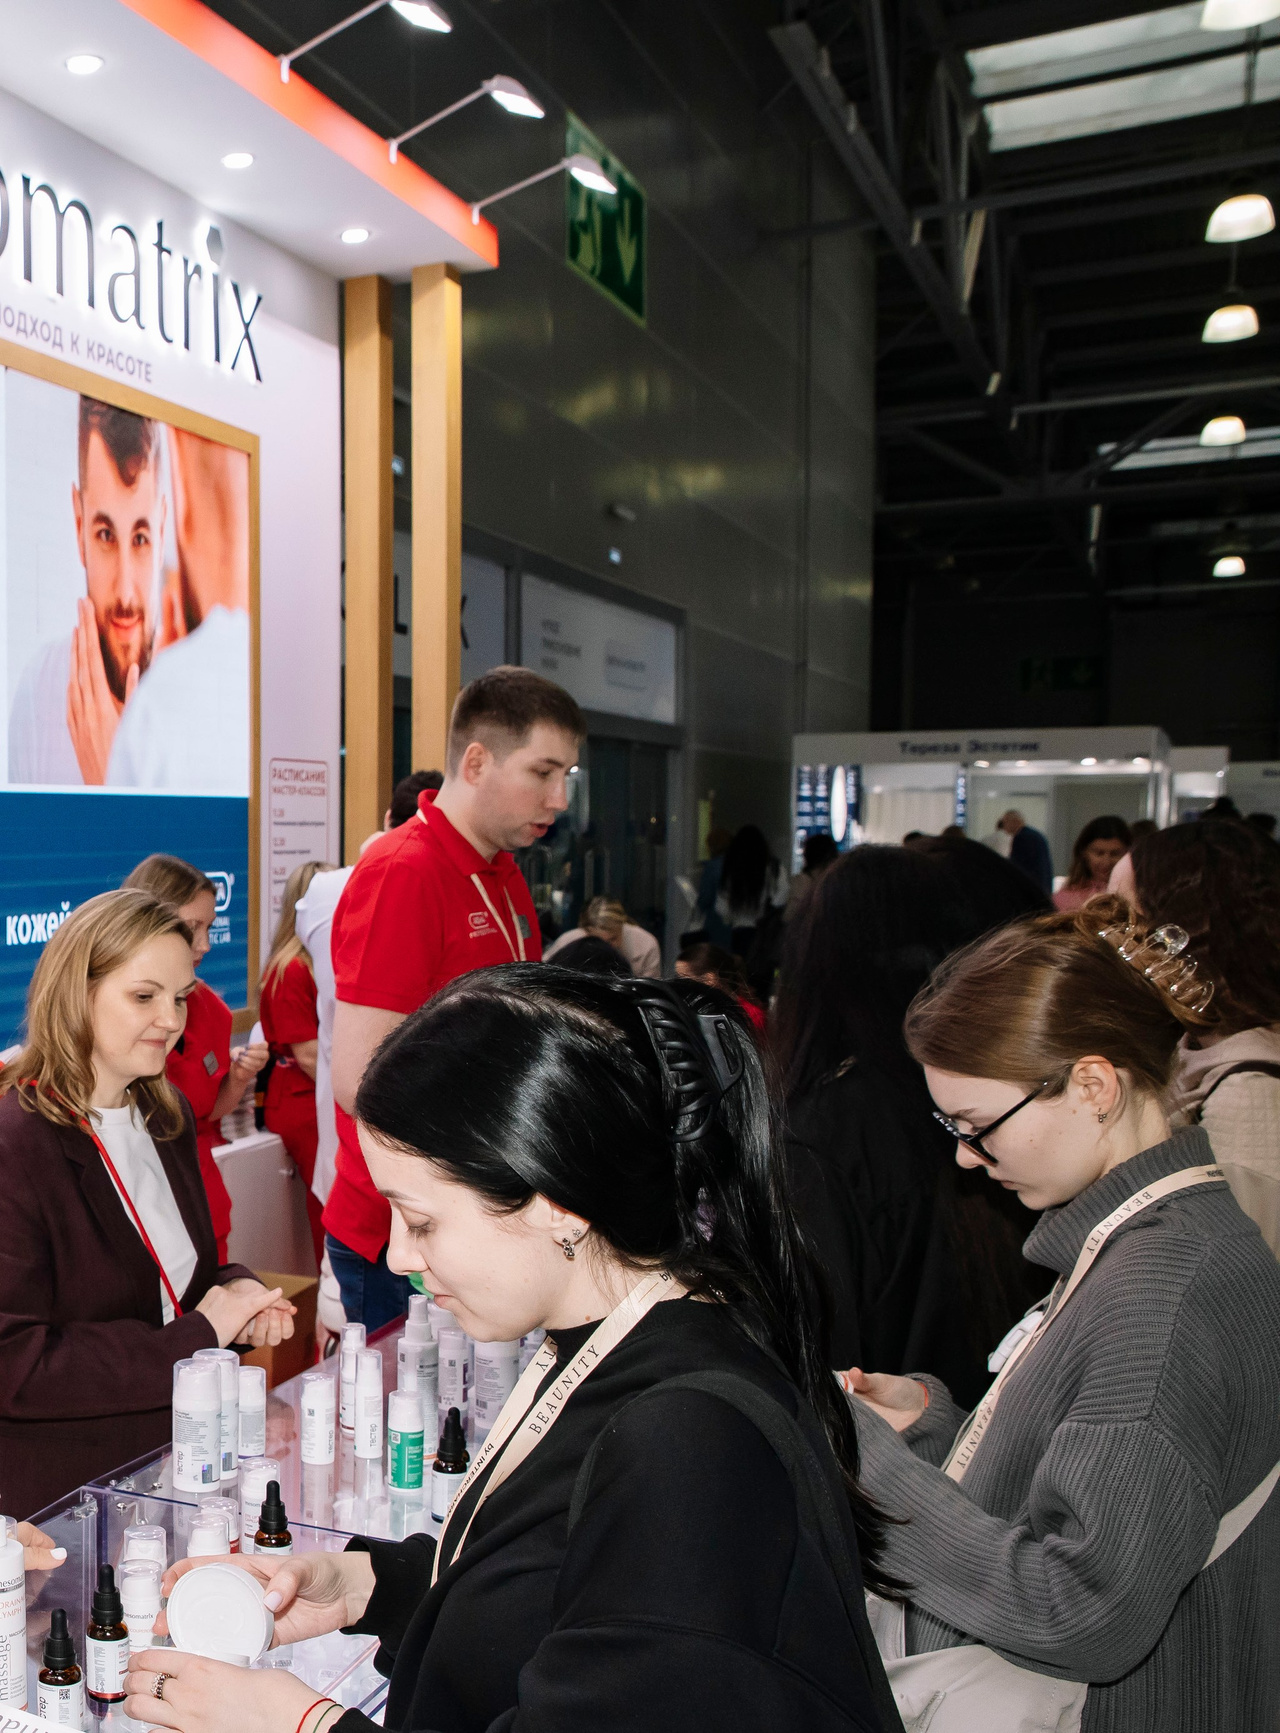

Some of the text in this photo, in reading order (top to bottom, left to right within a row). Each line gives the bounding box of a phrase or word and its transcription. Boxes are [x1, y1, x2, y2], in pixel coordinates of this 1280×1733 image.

[70, 331, 81, 356] К
[86, 338, 153, 384] КРАСОТЕ
[1086, 1191, 1154, 1255] BEAUNITY
[528, 1344, 601, 1435] BEAUNITY
[370, 1423, 378, 1448] тестер
[956, 1406, 994, 1471] BEAUNITY
[177, 1450, 185, 1476] тестер
[39, 1696, 49, 1719] стер
